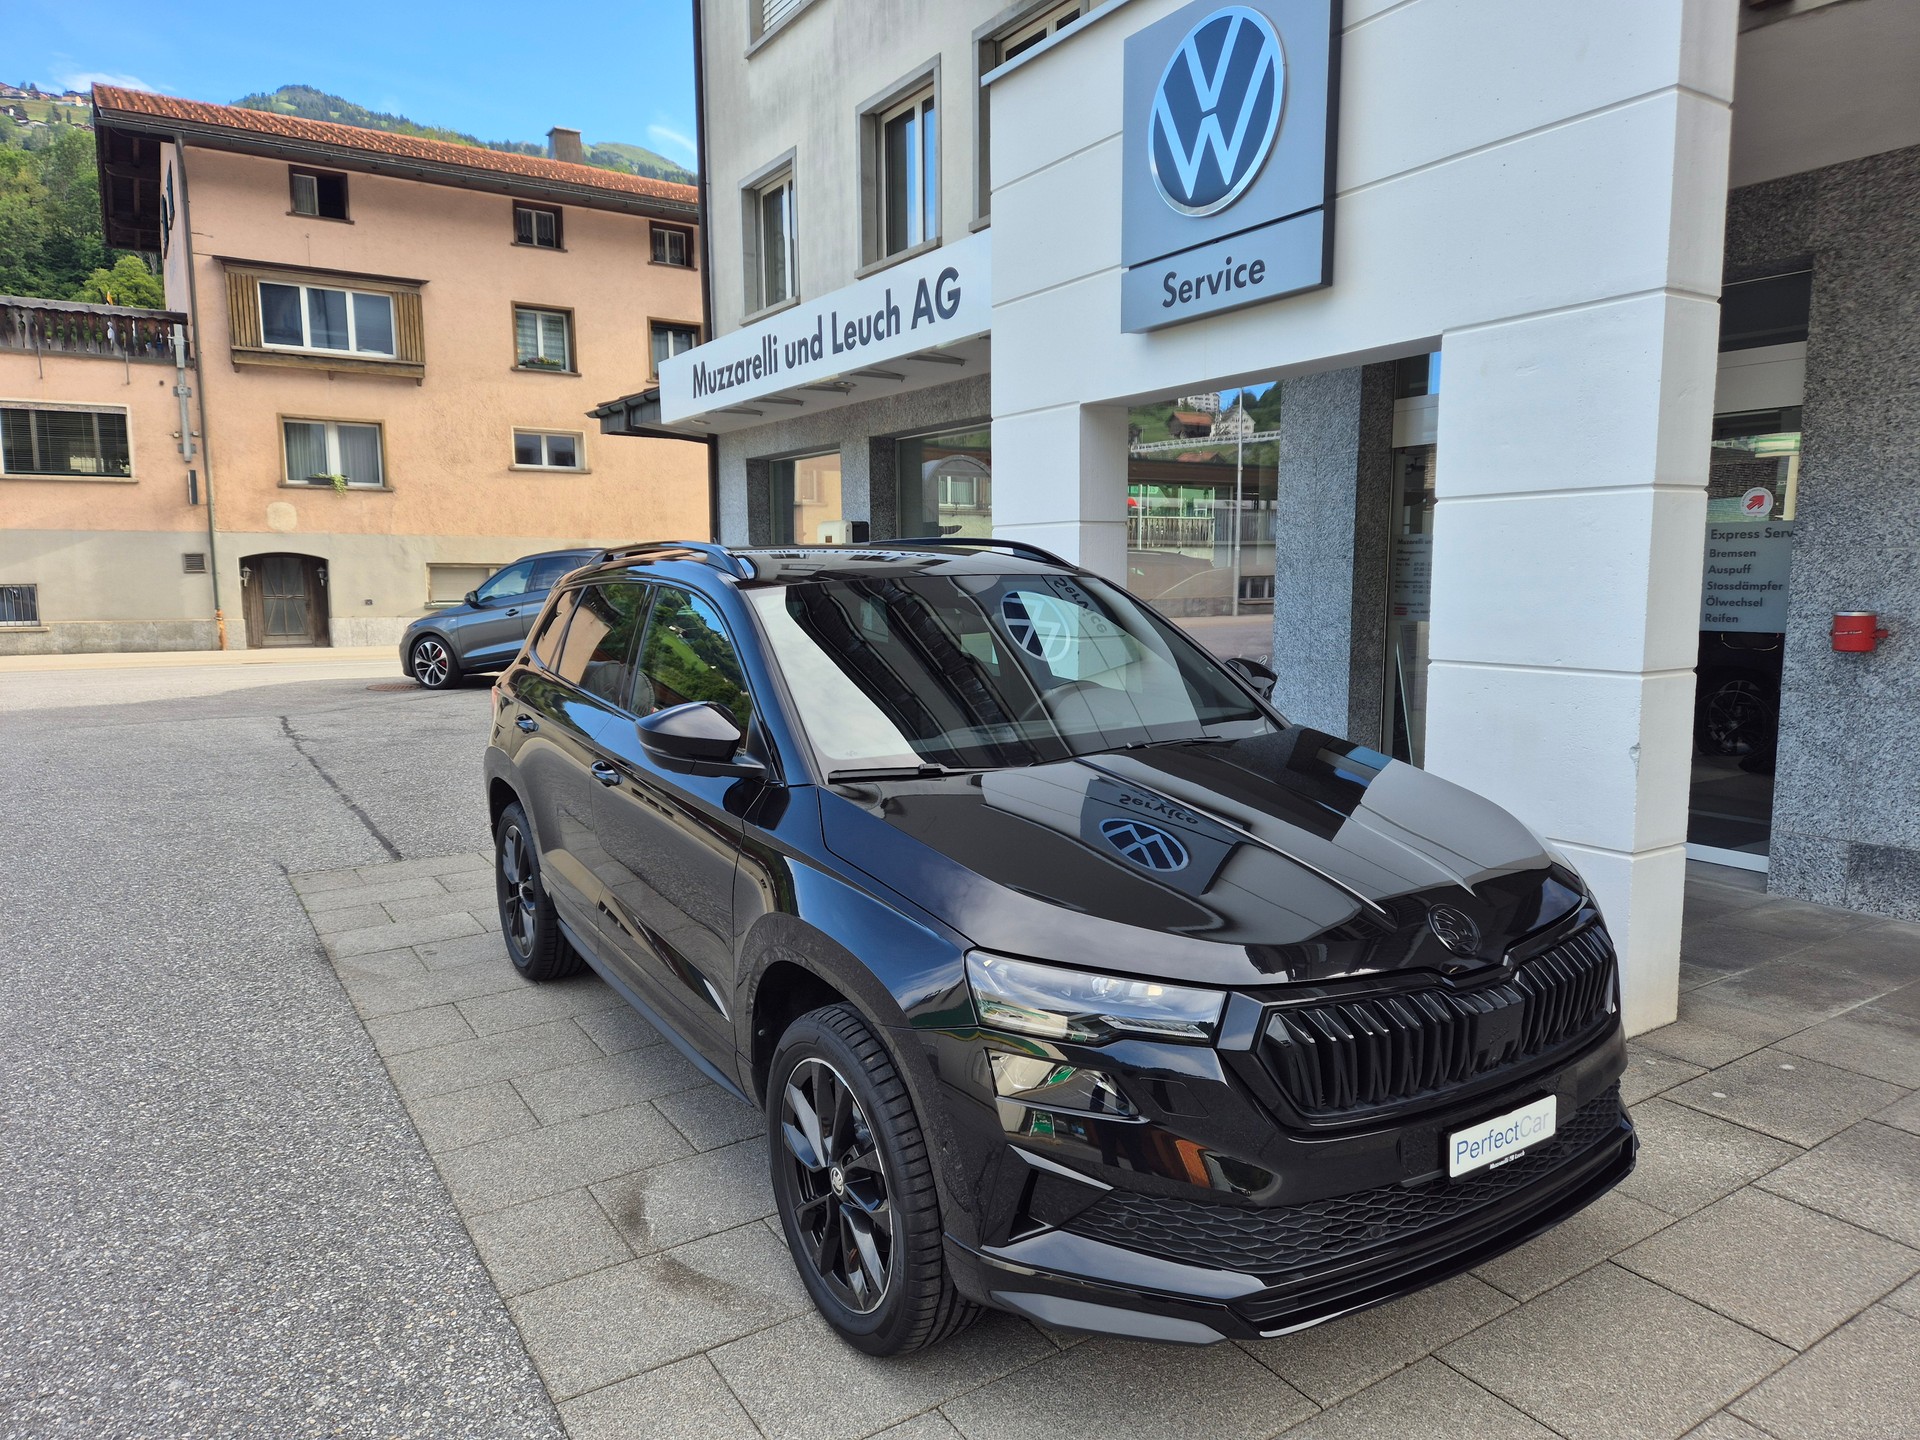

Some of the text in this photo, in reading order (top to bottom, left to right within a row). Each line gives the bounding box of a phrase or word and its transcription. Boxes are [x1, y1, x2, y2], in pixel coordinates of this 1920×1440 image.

[1148, 5, 1286, 216] VW
[1162, 256, 1266, 308] Service
[692, 266, 962, 399] Muzzarelli und Leuch AG
[1710, 529, 1760, 542] Express
[1709, 549, 1757, 558] Bremsen
[1708, 564, 1752, 576] Auspuff
[1707, 581, 1783, 593] Stossdämpfer
[1705, 595, 1763, 607] Ölwechsel
[1705, 613, 1739, 623] Reifen
[1456, 1112, 1549, 1165] PerfectCar
